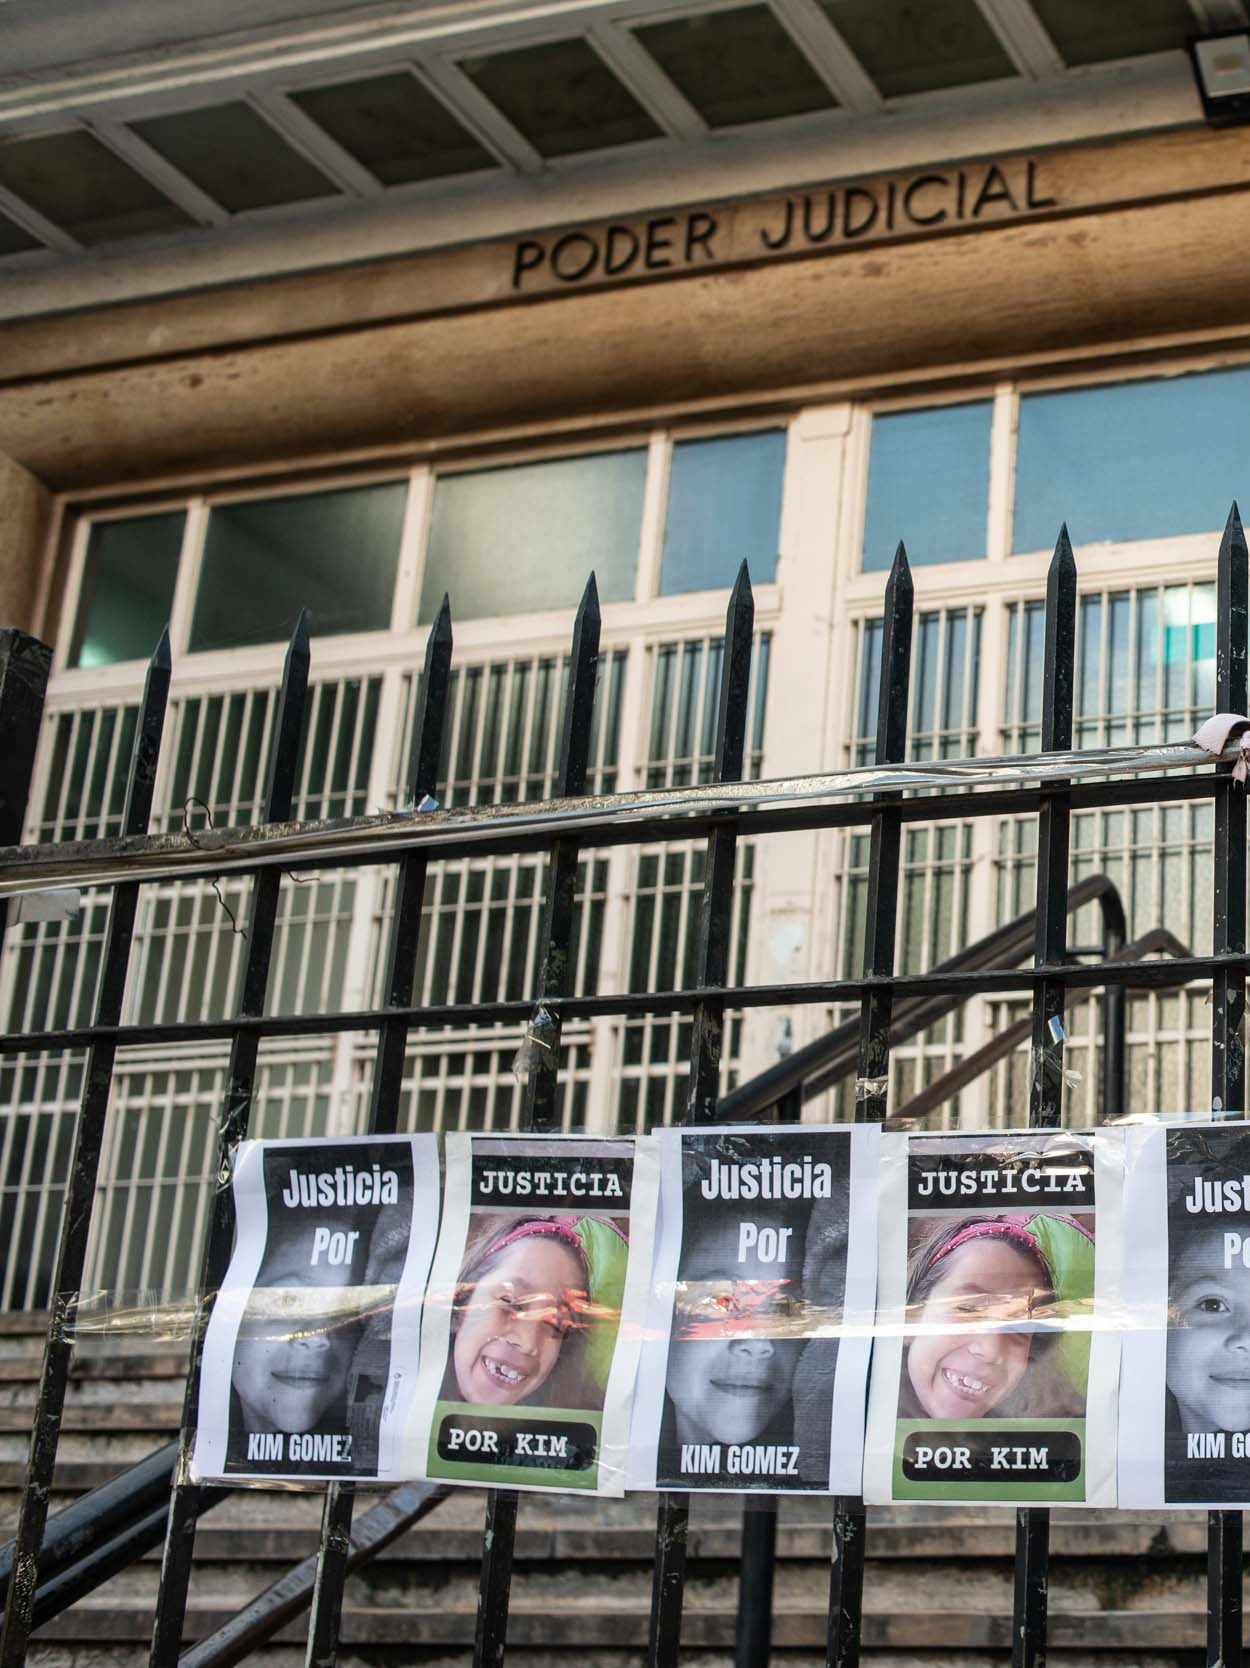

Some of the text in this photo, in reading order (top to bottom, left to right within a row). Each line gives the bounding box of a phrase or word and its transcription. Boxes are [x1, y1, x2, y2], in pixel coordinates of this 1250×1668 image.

[512, 161, 1057, 288] PODER JUDICIAL
[283, 1164, 398, 1208] Justicia
[479, 1171, 623, 1196] JUSTICIA
[701, 1155, 832, 1200] Justicia
[918, 1170, 1086, 1195] JUSTICIA
[310, 1227, 358, 1265] Por
[738, 1222, 792, 1262] Por
[247, 1433, 352, 1462] KIM GOMEZ
[447, 1429, 568, 1457] POR KIM
[1187, 1433, 1224, 1458] KIM
[681, 1445, 800, 1475] KIM GOMEZ
[915, 1447, 1049, 1469] POR KIM
